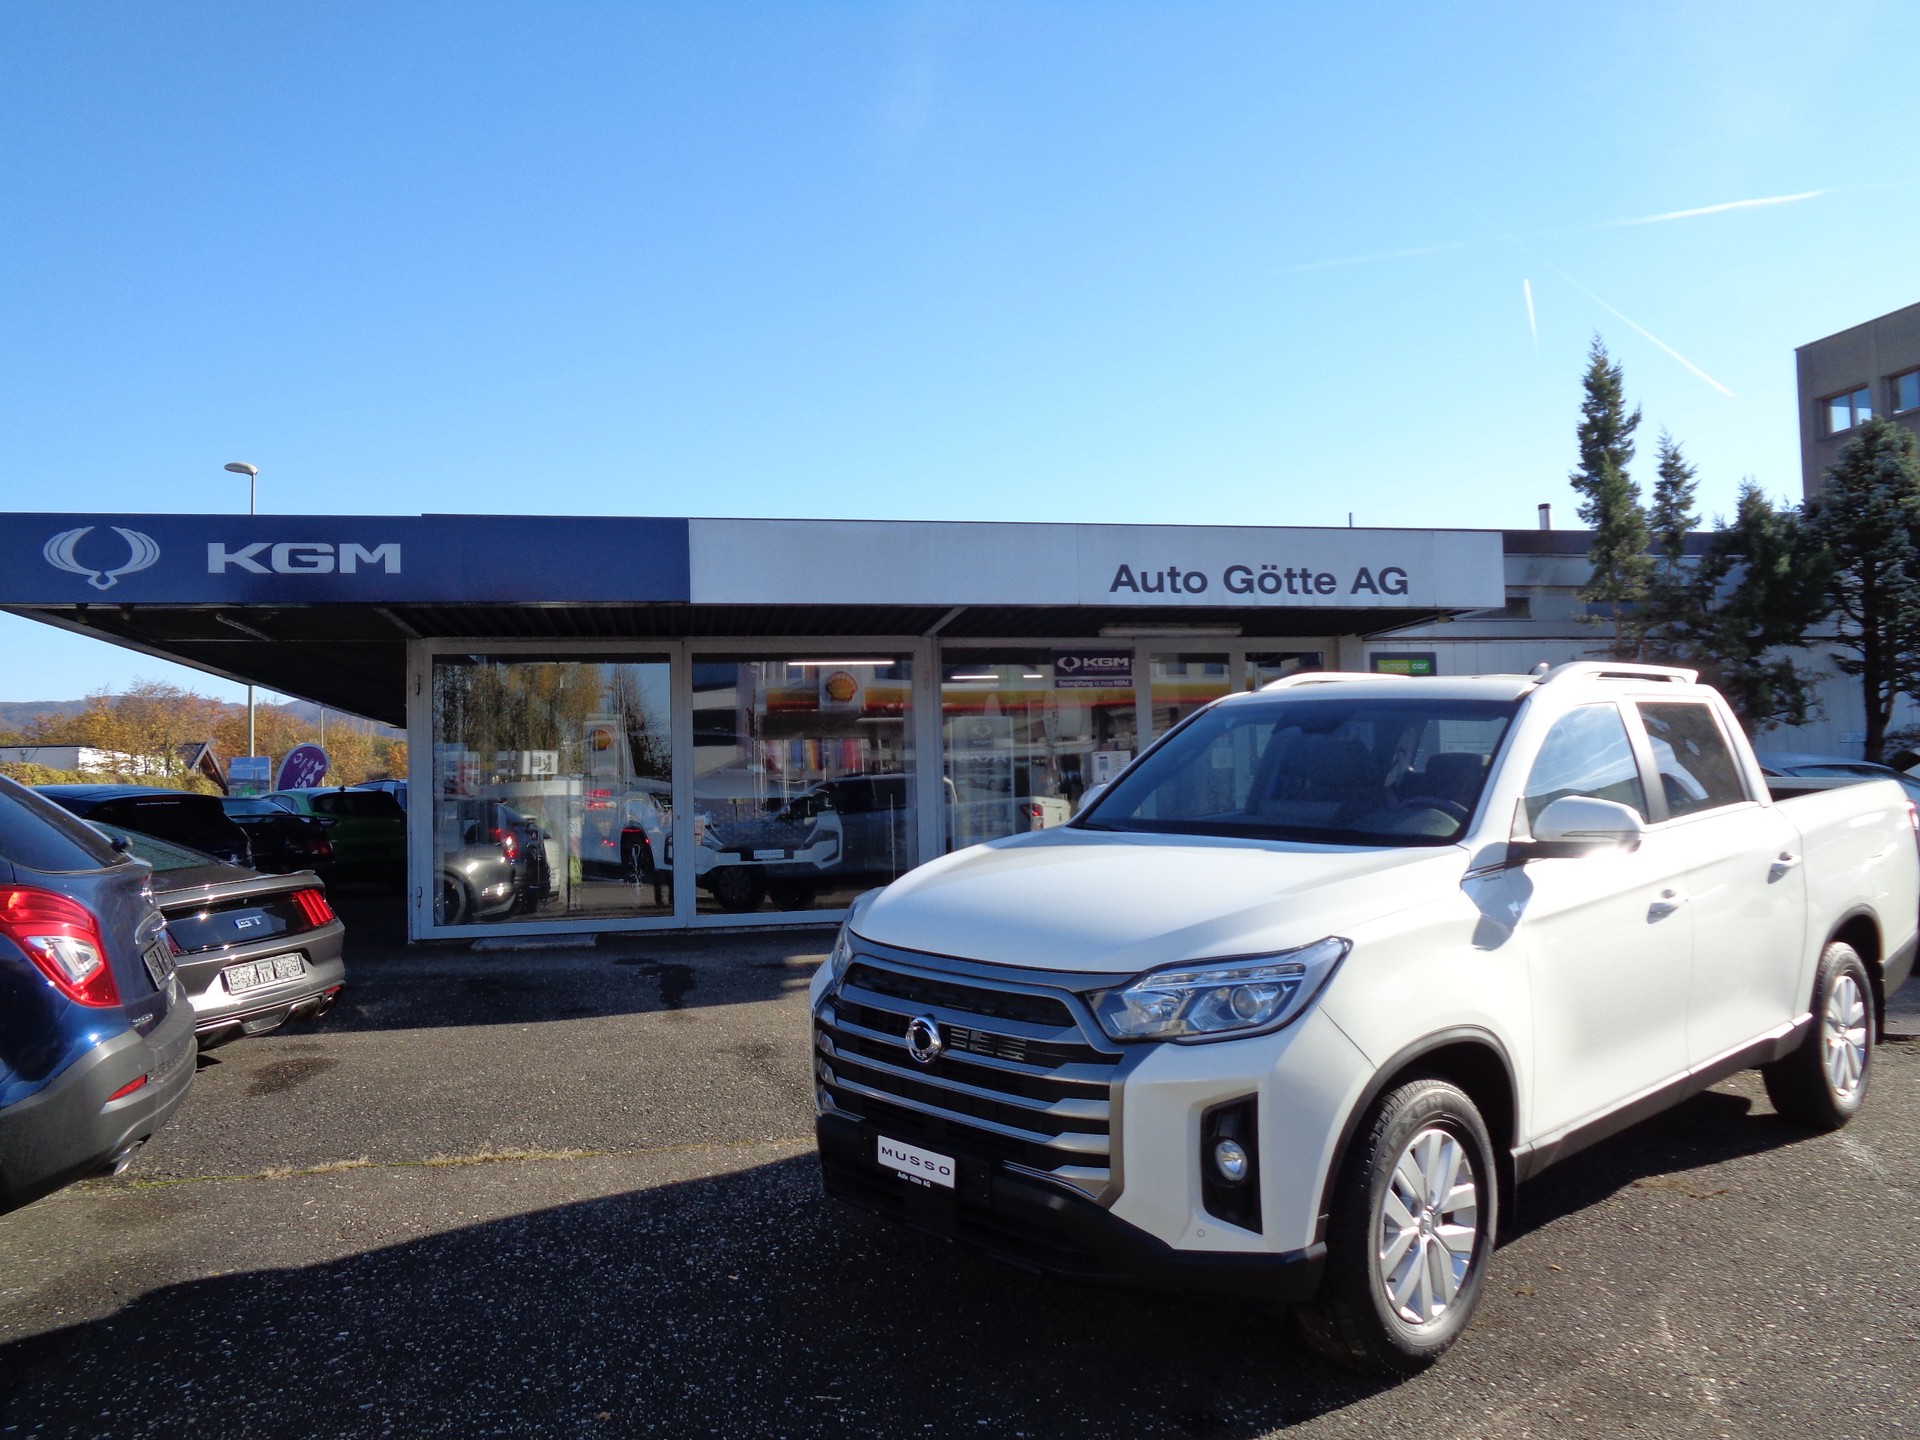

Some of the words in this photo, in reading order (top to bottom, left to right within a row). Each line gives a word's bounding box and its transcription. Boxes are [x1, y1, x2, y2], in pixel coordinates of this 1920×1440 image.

[207, 542, 401, 574] KGM
[1109, 564, 1209, 593] Auto
[1223, 564, 1338, 595] Götte
[1349, 566, 1409, 595] AG
[1083, 657, 1129, 667] KGM
[235, 915, 262, 929] GT
[881, 1146, 951, 1176] MUSSO
